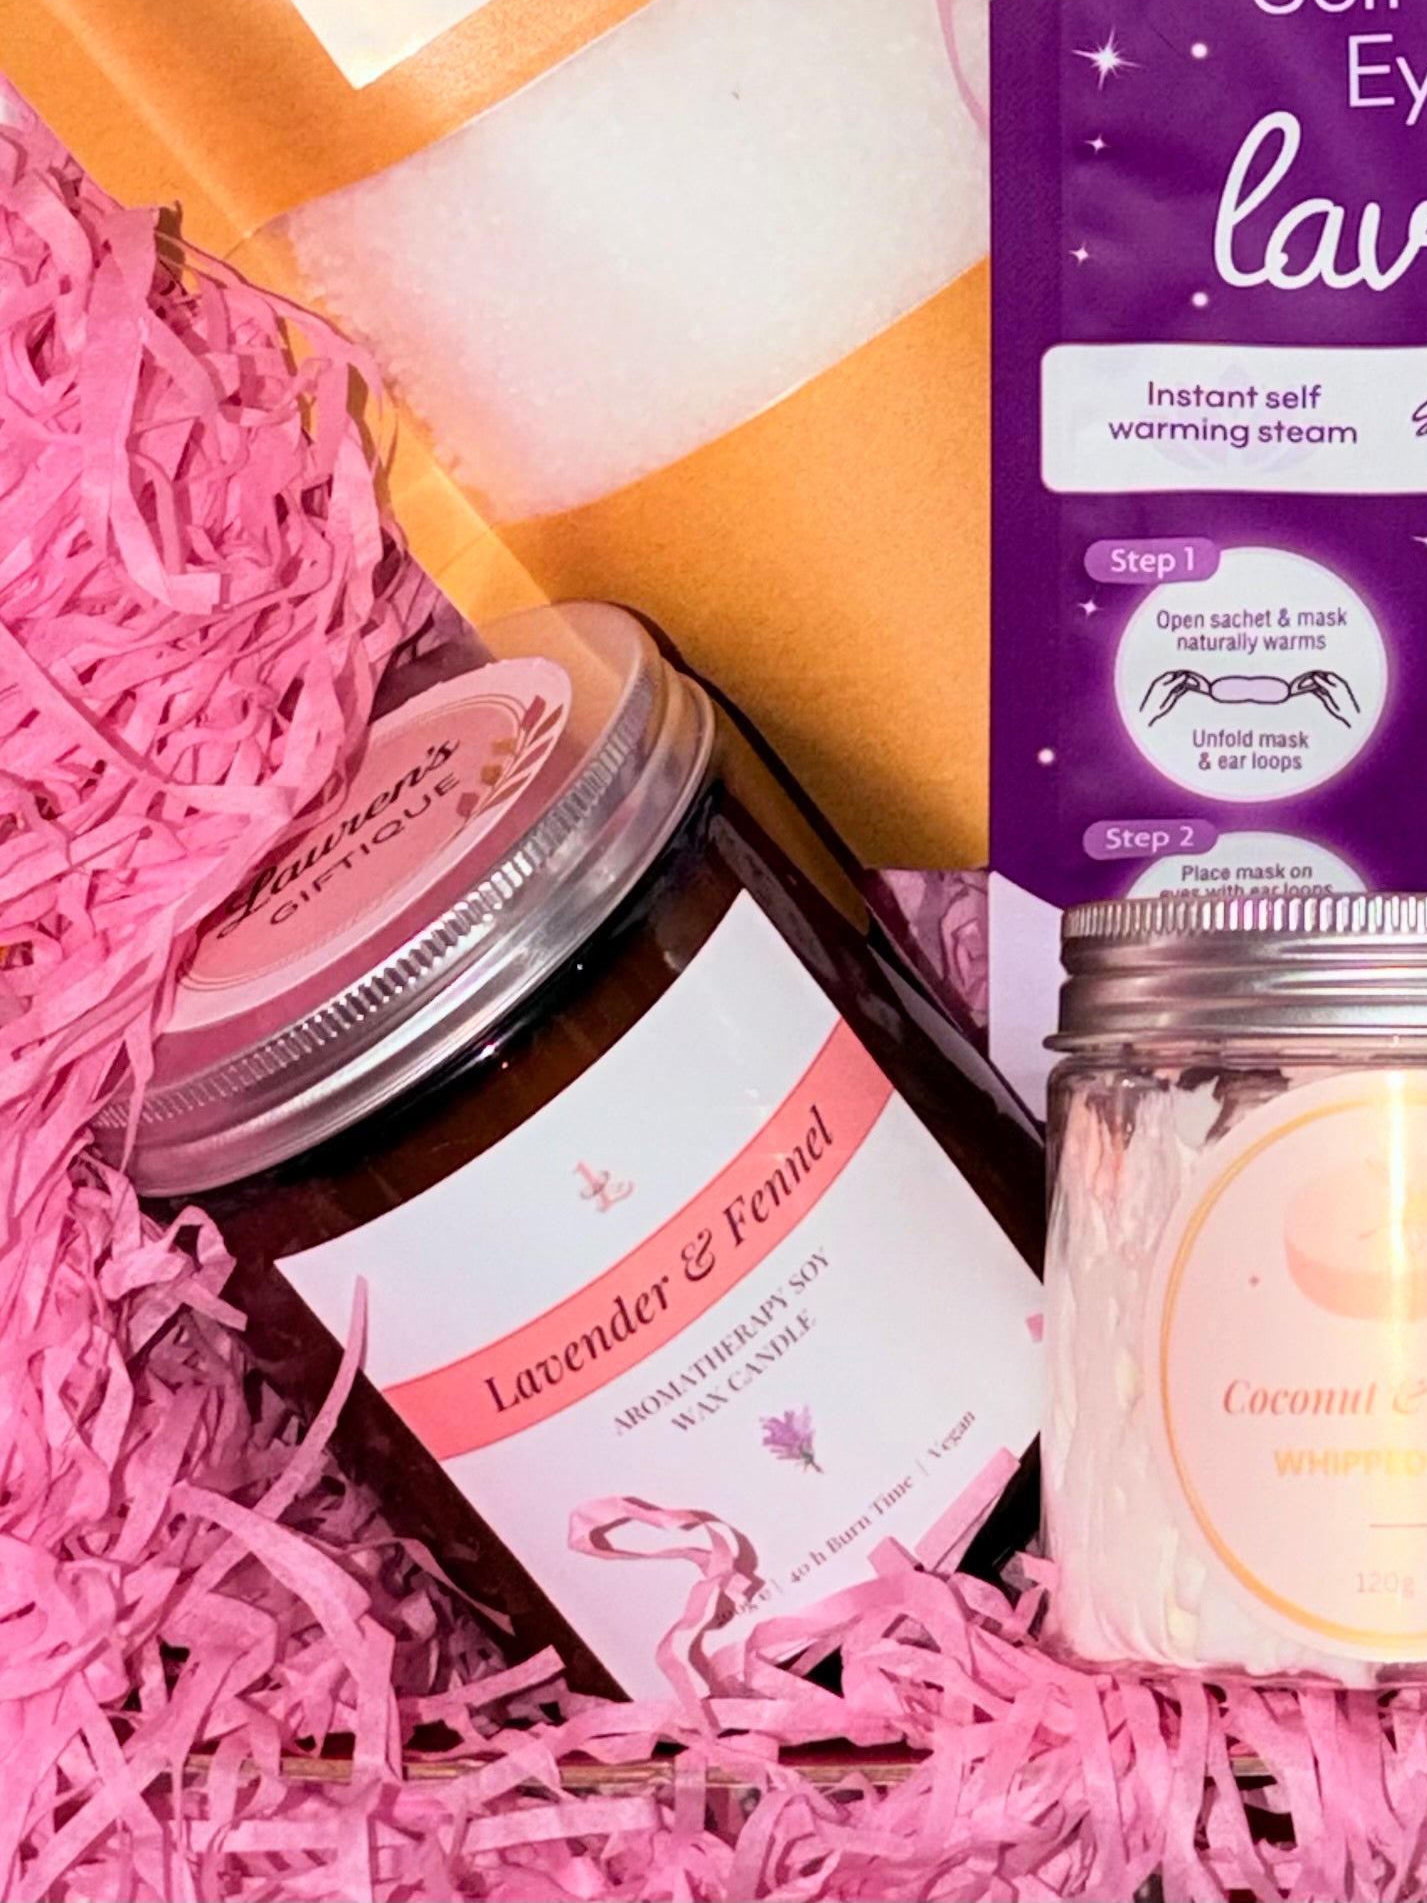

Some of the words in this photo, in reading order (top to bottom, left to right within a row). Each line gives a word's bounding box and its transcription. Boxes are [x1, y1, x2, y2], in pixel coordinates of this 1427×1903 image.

[1148, 381, 1259, 409] Instant
[1265, 384, 1322, 410] self
[1108, 418, 1249, 449] warming
[1258, 420, 1358, 444] steam
[1110, 548, 1176, 579] Step
[1184, 546, 1195, 571] 1
[1156, 609, 1204, 633] Open
[1210, 608, 1272, 629] sachet
[1277, 607, 1291, 627] &
[1297, 606, 1348, 627] mask
[1177, 632, 1258, 655] naturally
[1263, 634, 1327, 651] warms
[1192, 729, 1253, 748] Unfold
[1259, 730, 1310, 749] mask
[1198, 752, 1211, 771] &
[1218, 754, 1247, 770] ear
[1252, 752, 1302, 773] loops
[270, 772, 460, 926] GIFTIQUE
[1105, 827, 1170, 853] Step
[1179, 825, 1195, 847] 2
[1181, 865, 1231, 882] Place
[1236, 863, 1285, 880] mask
[1290, 865, 1313, 880] on
[481, 1274, 672, 1414] Lavender
[680, 1227, 716, 1282] &
[722, 1103, 836, 1249] Fennel
[615, 1286, 789, 1436] AROMATHERAPY
[788, 1246, 829, 1295] SOY
[670, 1385, 729, 1431] WAX
[727, 1308, 817, 1392] CANDLE
[1223, 1378, 1377, 1416] Coconut
[1273, 1448, 1427, 1477] WHIPPED
[825, 1513, 872, 1555] Burn
[869, 1474, 914, 1516] Time
[928, 1410, 976, 1459] Vegan
[1356, 1571, 1415, 1598] 120g
